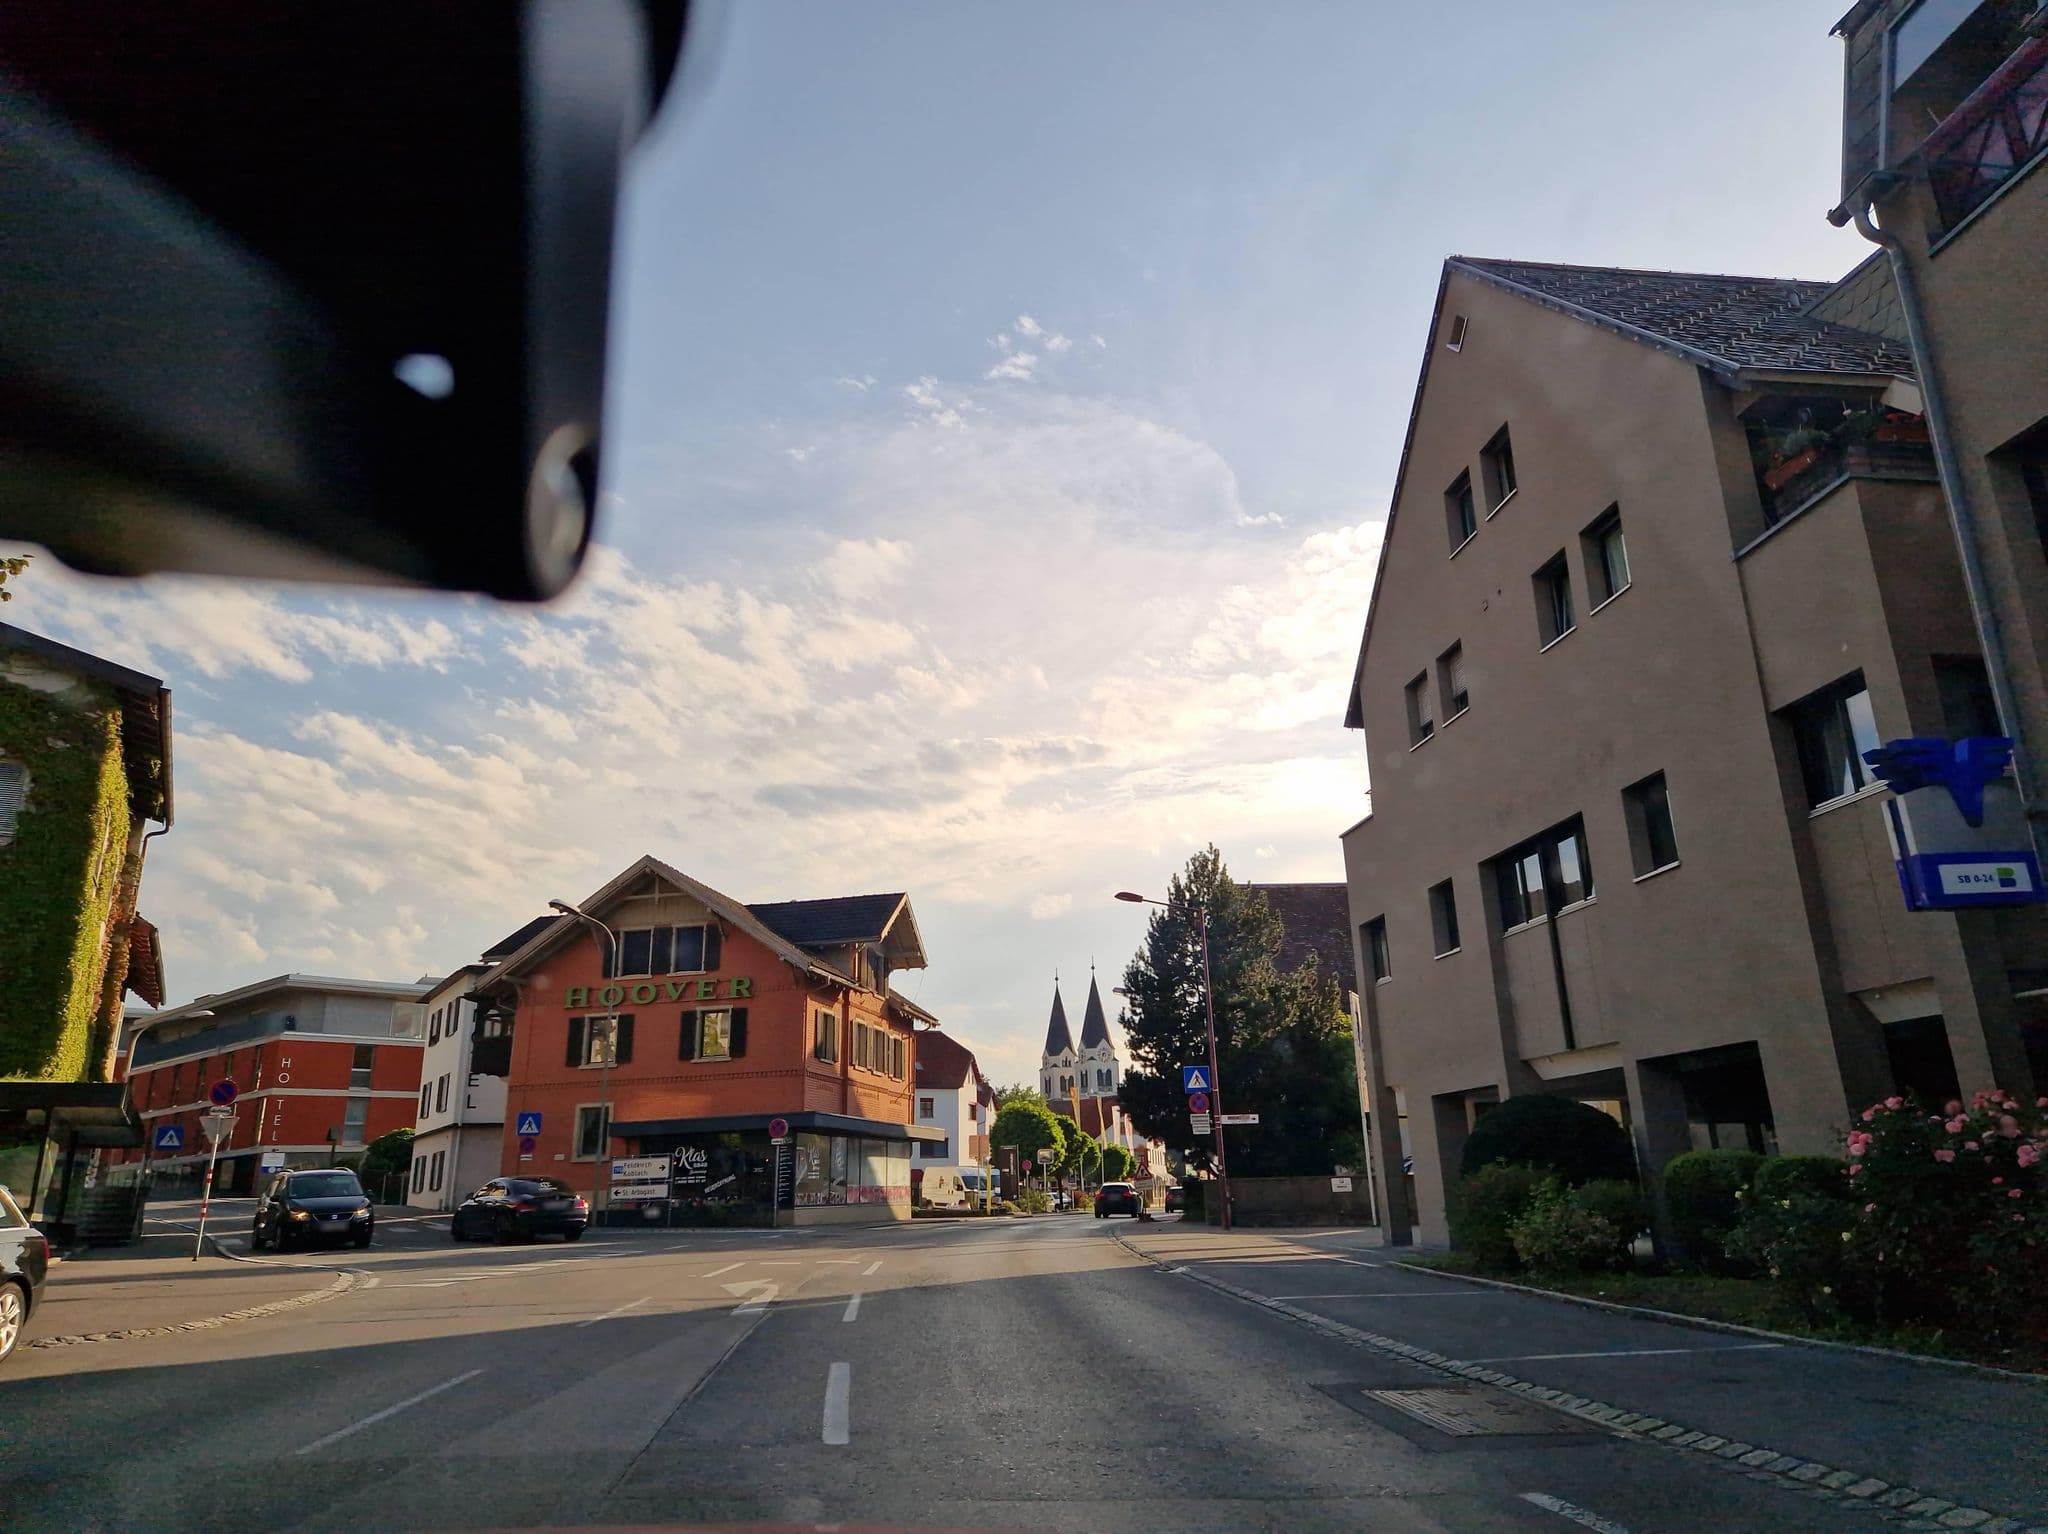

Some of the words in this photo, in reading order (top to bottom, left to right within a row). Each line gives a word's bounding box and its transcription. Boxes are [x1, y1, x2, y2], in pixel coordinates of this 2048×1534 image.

[1958, 875, 1971, 883] SB
[1973, 874, 1994, 883] 0-24
[564, 976, 752, 1008] HOOVER
[272, 1057, 291, 1141] HOTEL
[623, 1161, 652, 1169] Feldkirch
